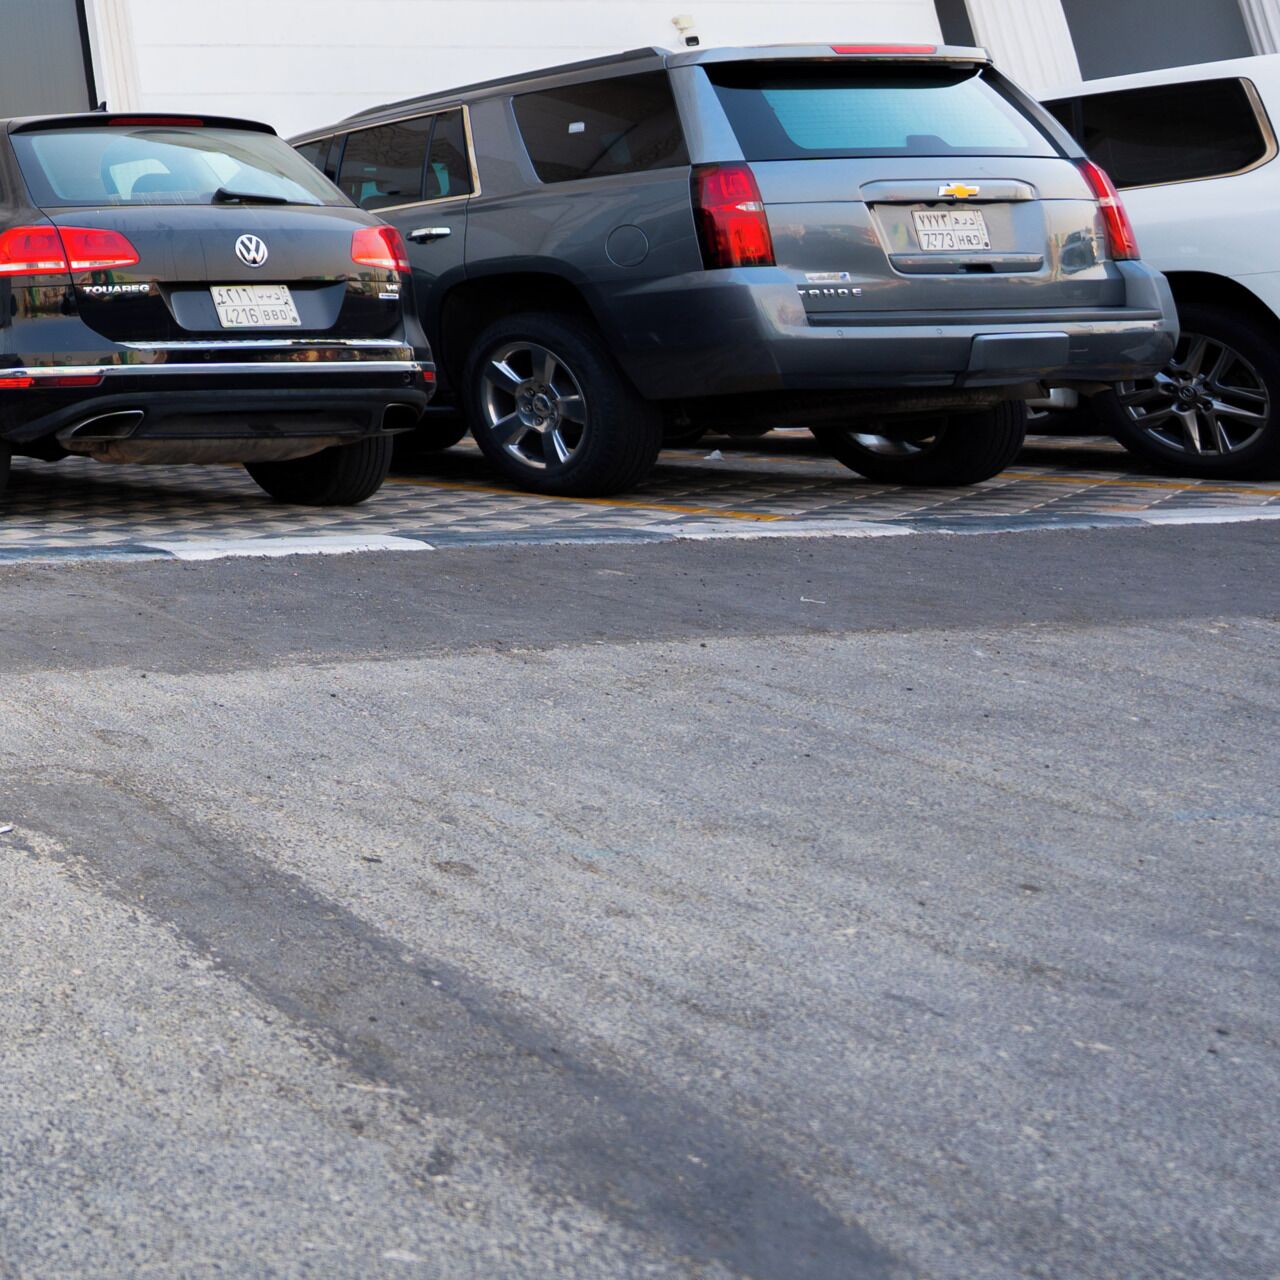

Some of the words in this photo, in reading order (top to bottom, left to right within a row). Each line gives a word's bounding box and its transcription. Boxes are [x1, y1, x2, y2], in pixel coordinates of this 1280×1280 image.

[83, 283, 150, 294] TOUAREG
[797, 287, 863, 297] TAHOE
[217, 288, 253, 305] ٤٢١٦
[225, 307, 259, 325] 4216
